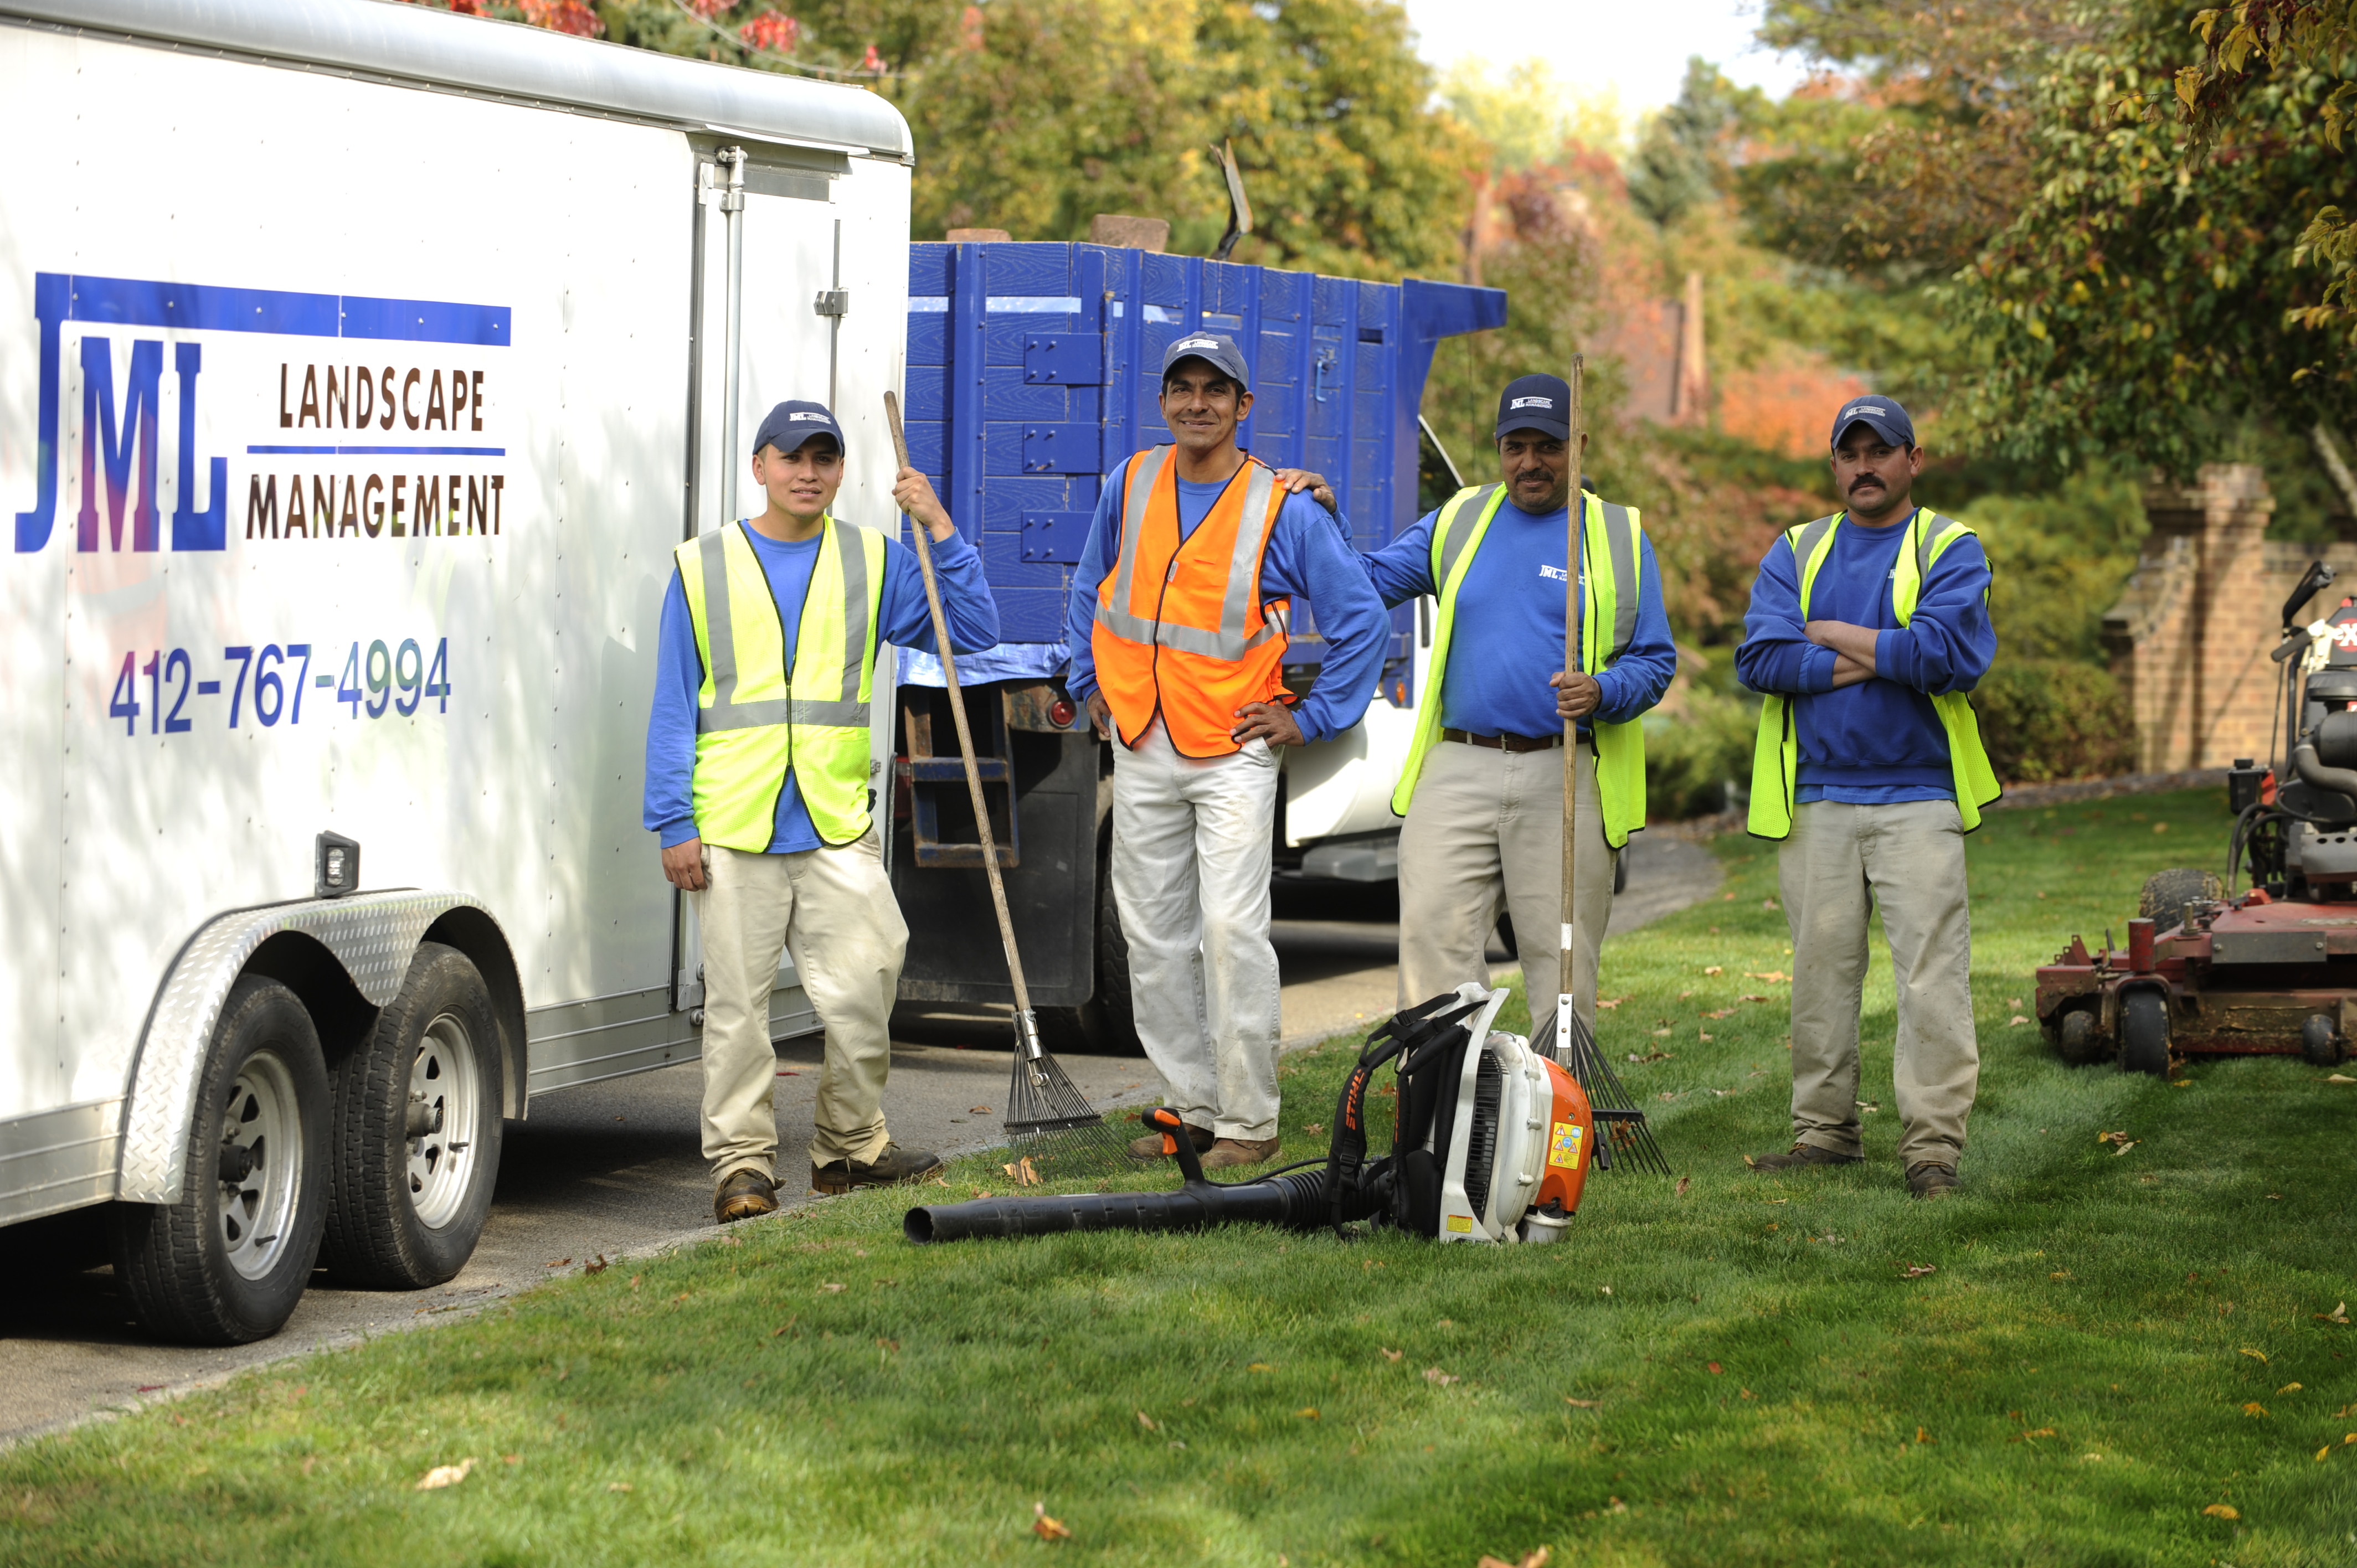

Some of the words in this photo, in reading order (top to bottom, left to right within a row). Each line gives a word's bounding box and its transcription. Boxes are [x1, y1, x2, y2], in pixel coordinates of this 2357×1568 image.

[14, 271, 228, 553] JML
[279, 363, 484, 431] LANDSCAPE
[789, 413, 807, 421] JML
[1510, 399, 1525, 410] JML
[245, 473, 505, 540] MANAGEMENT
[1538, 565, 1558, 579] JML
[109, 637, 451, 737] 412-767-4994
